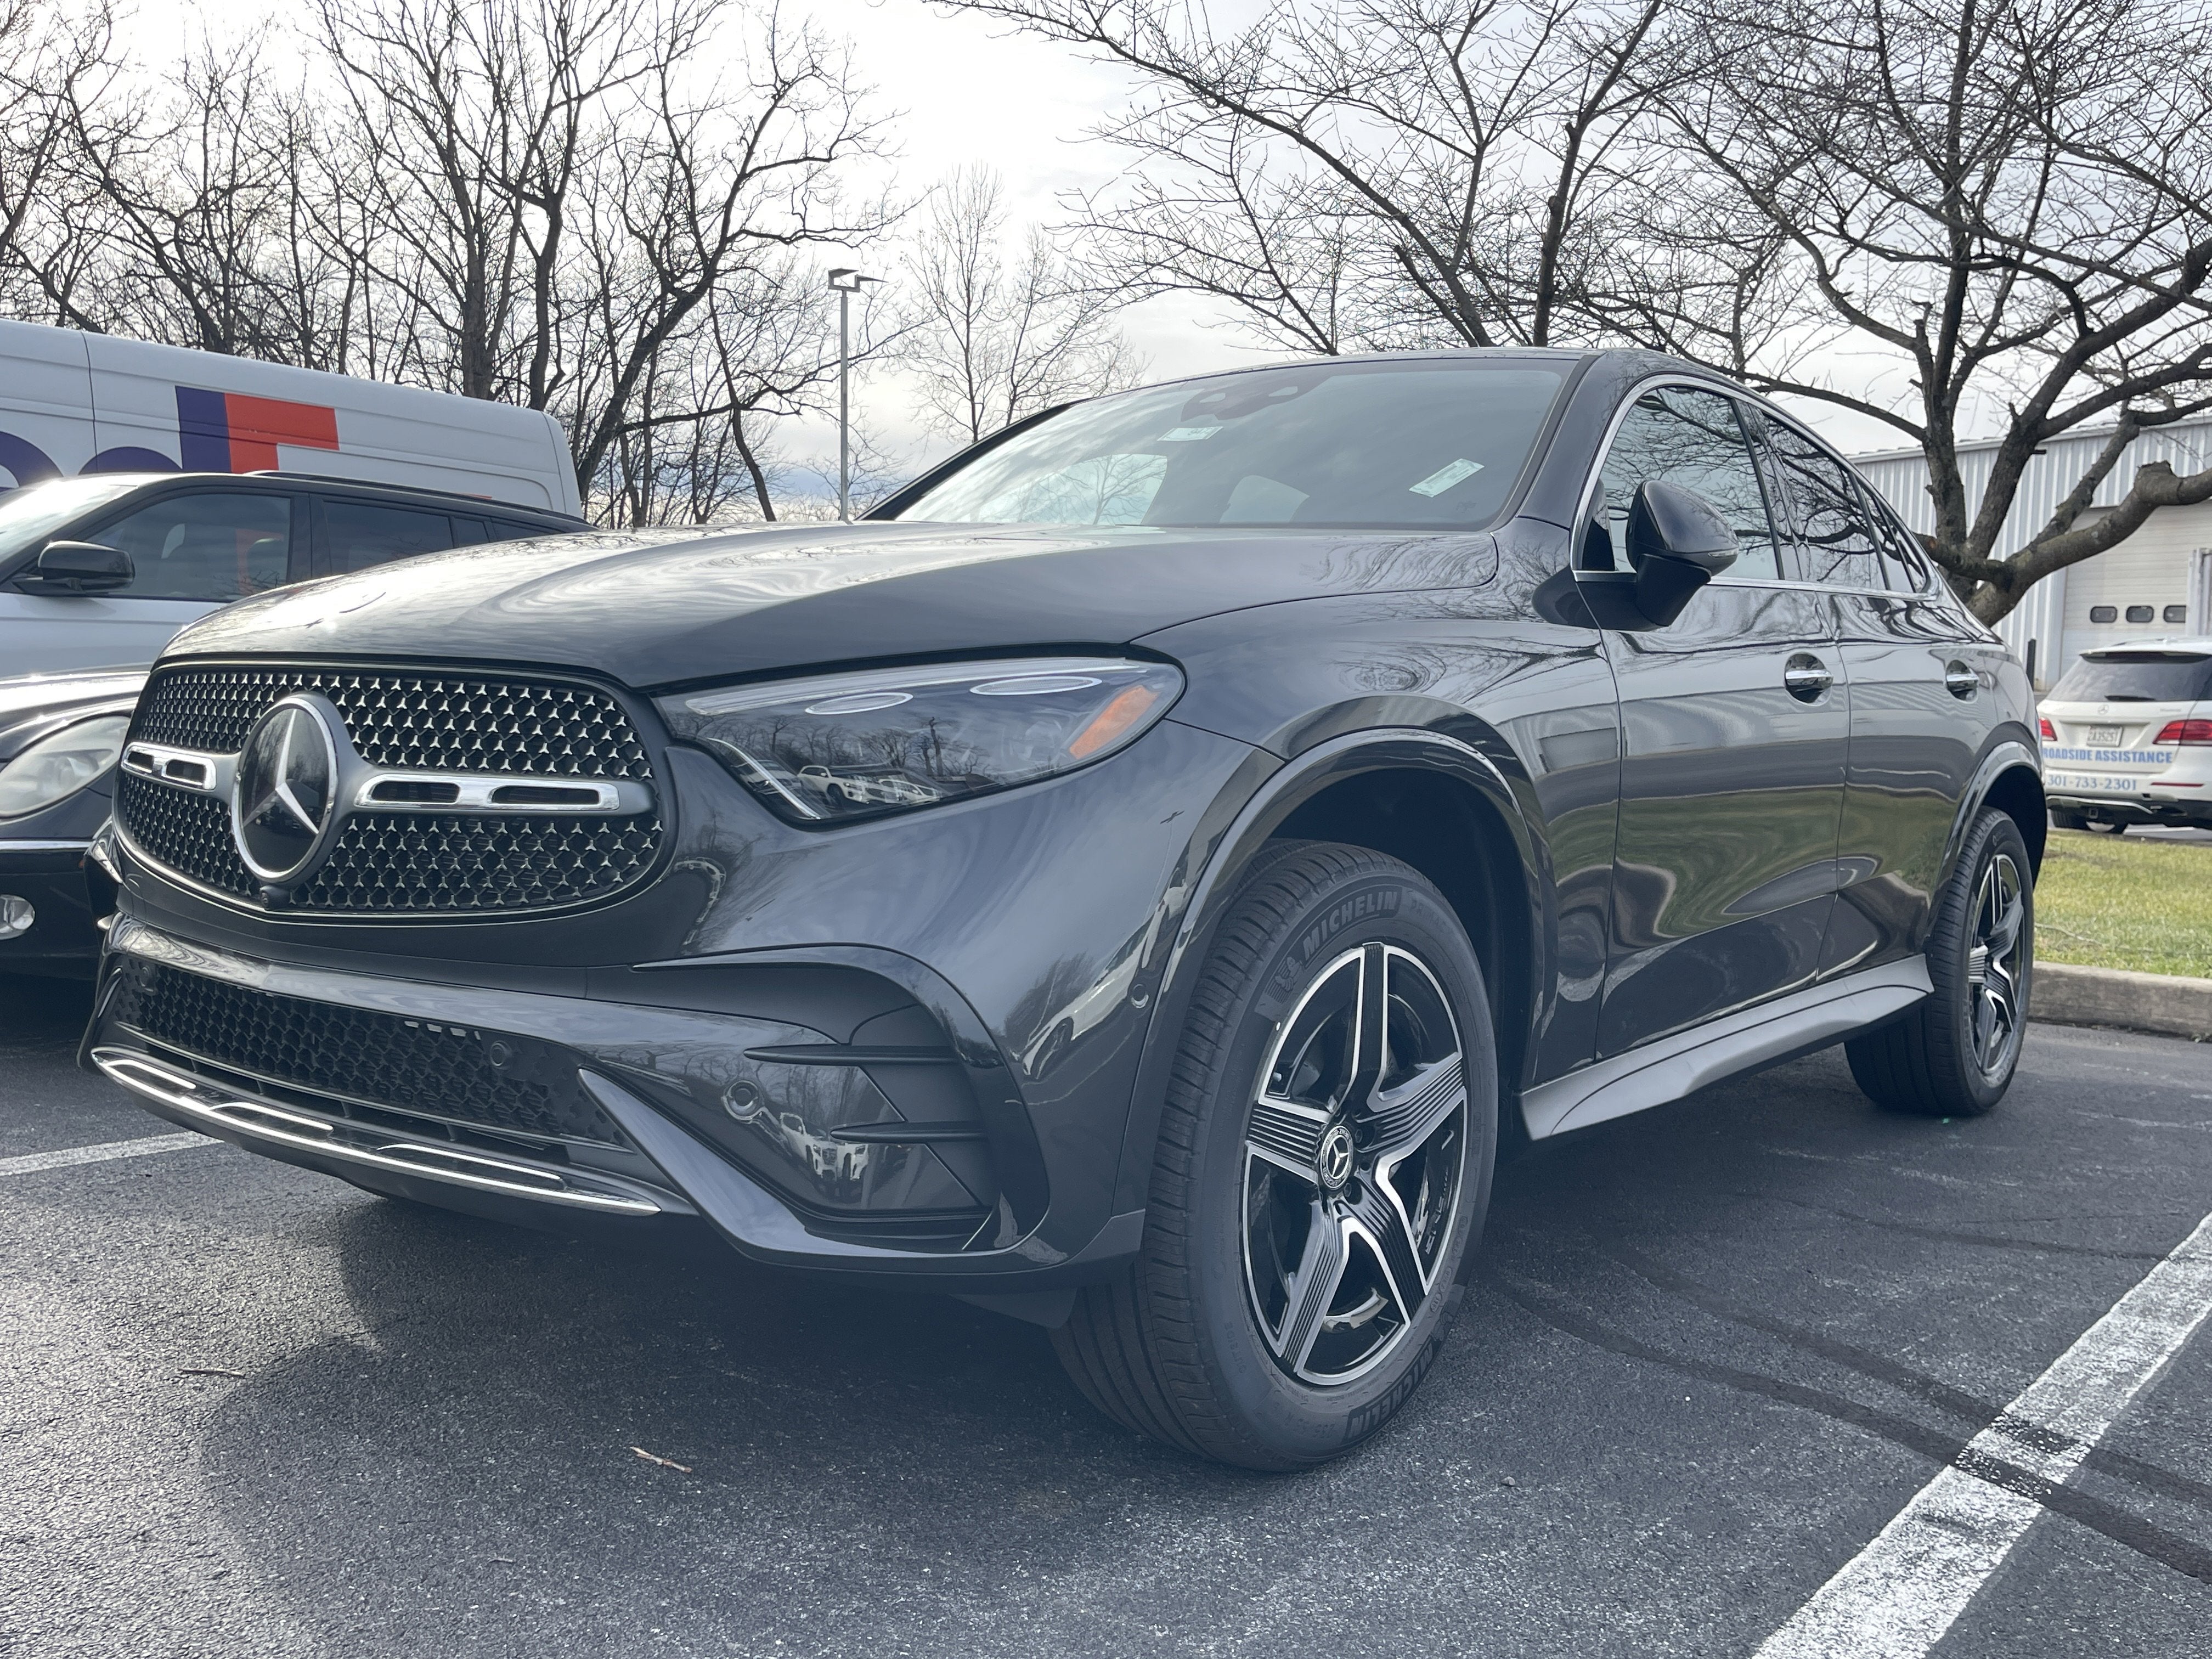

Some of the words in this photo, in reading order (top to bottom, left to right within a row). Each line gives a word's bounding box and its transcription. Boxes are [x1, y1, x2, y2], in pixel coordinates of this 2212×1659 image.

[2042, 748, 2092, 760] ROADSIDE
[2095, 751, 2173, 763] ASSISTANCE
[1303, 891, 1398, 961] MICHELIN
[1347, 1342, 1433, 1438] MICHELIN
